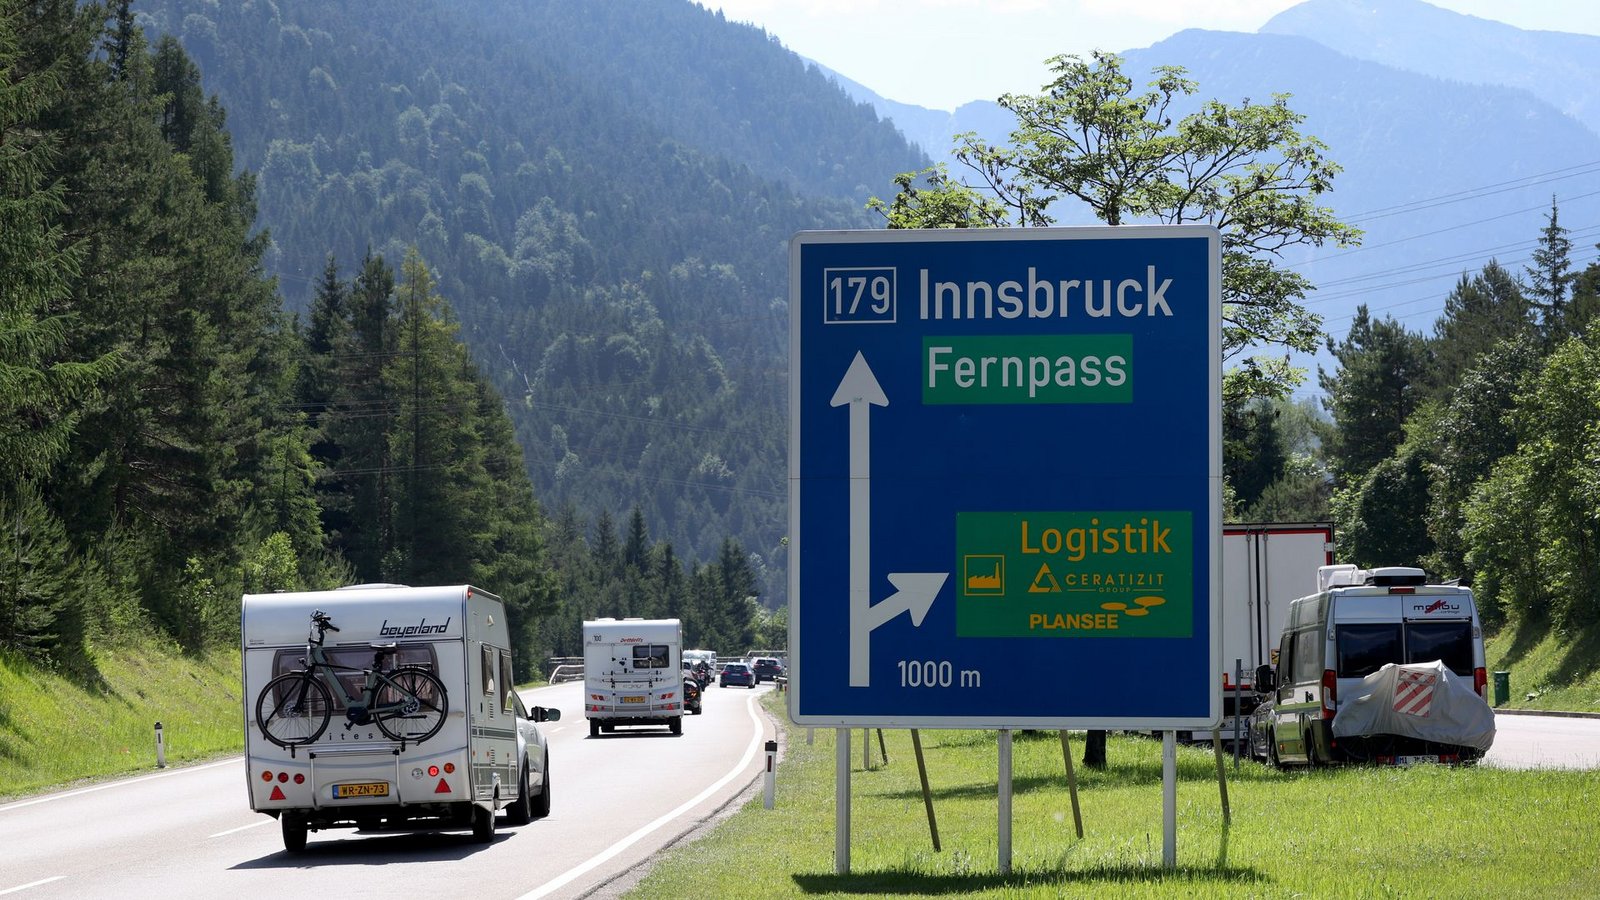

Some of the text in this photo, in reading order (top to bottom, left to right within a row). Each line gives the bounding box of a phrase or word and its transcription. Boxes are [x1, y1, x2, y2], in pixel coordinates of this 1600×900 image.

[831, 275, 890, 316] 179
[919, 264, 1174, 321] Innsbruck
[928, 346, 1127, 398] Fernpass
[1021, 518, 1172, 561] Logistik
[1065, 573, 1164, 585] CERATIZIT
[379, 616, 451, 638] beyerland
[1029, 613, 1118, 629] PLANSEE
[897, 659, 981, 688] 1000 m
[341, 784, 385, 795] WR-ZN-73
